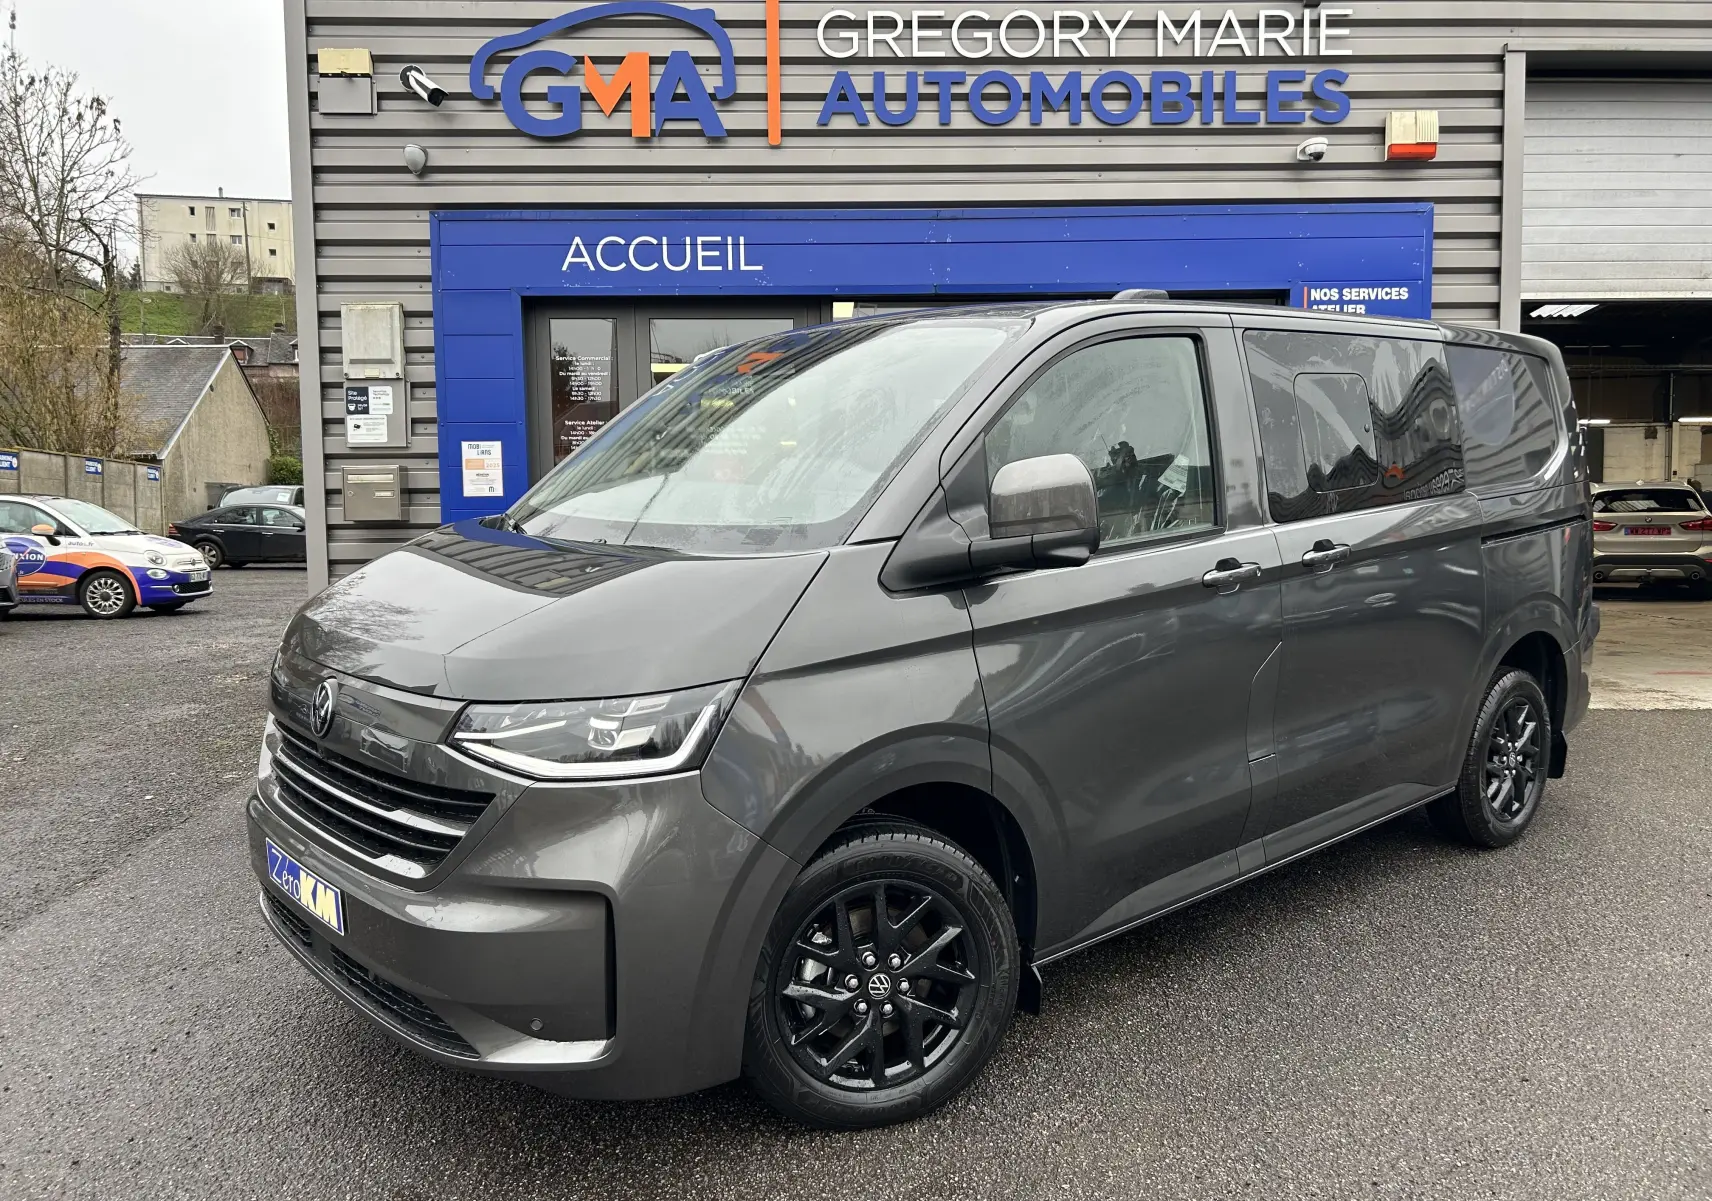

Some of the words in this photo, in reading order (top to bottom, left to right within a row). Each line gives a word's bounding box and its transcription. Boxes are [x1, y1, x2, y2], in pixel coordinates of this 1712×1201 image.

[816, 9, 1134, 59] GREGORY
[1156, 8, 1354, 58] MARIE
[501, 49, 728, 137] GMA
[816, 69, 1351, 126] AUTOMOBILES
[561, 236, 764, 271] ACCUEIL
[1310, 288, 1339, 301] NOS
[1342, 287, 1409, 300] SERVICES
